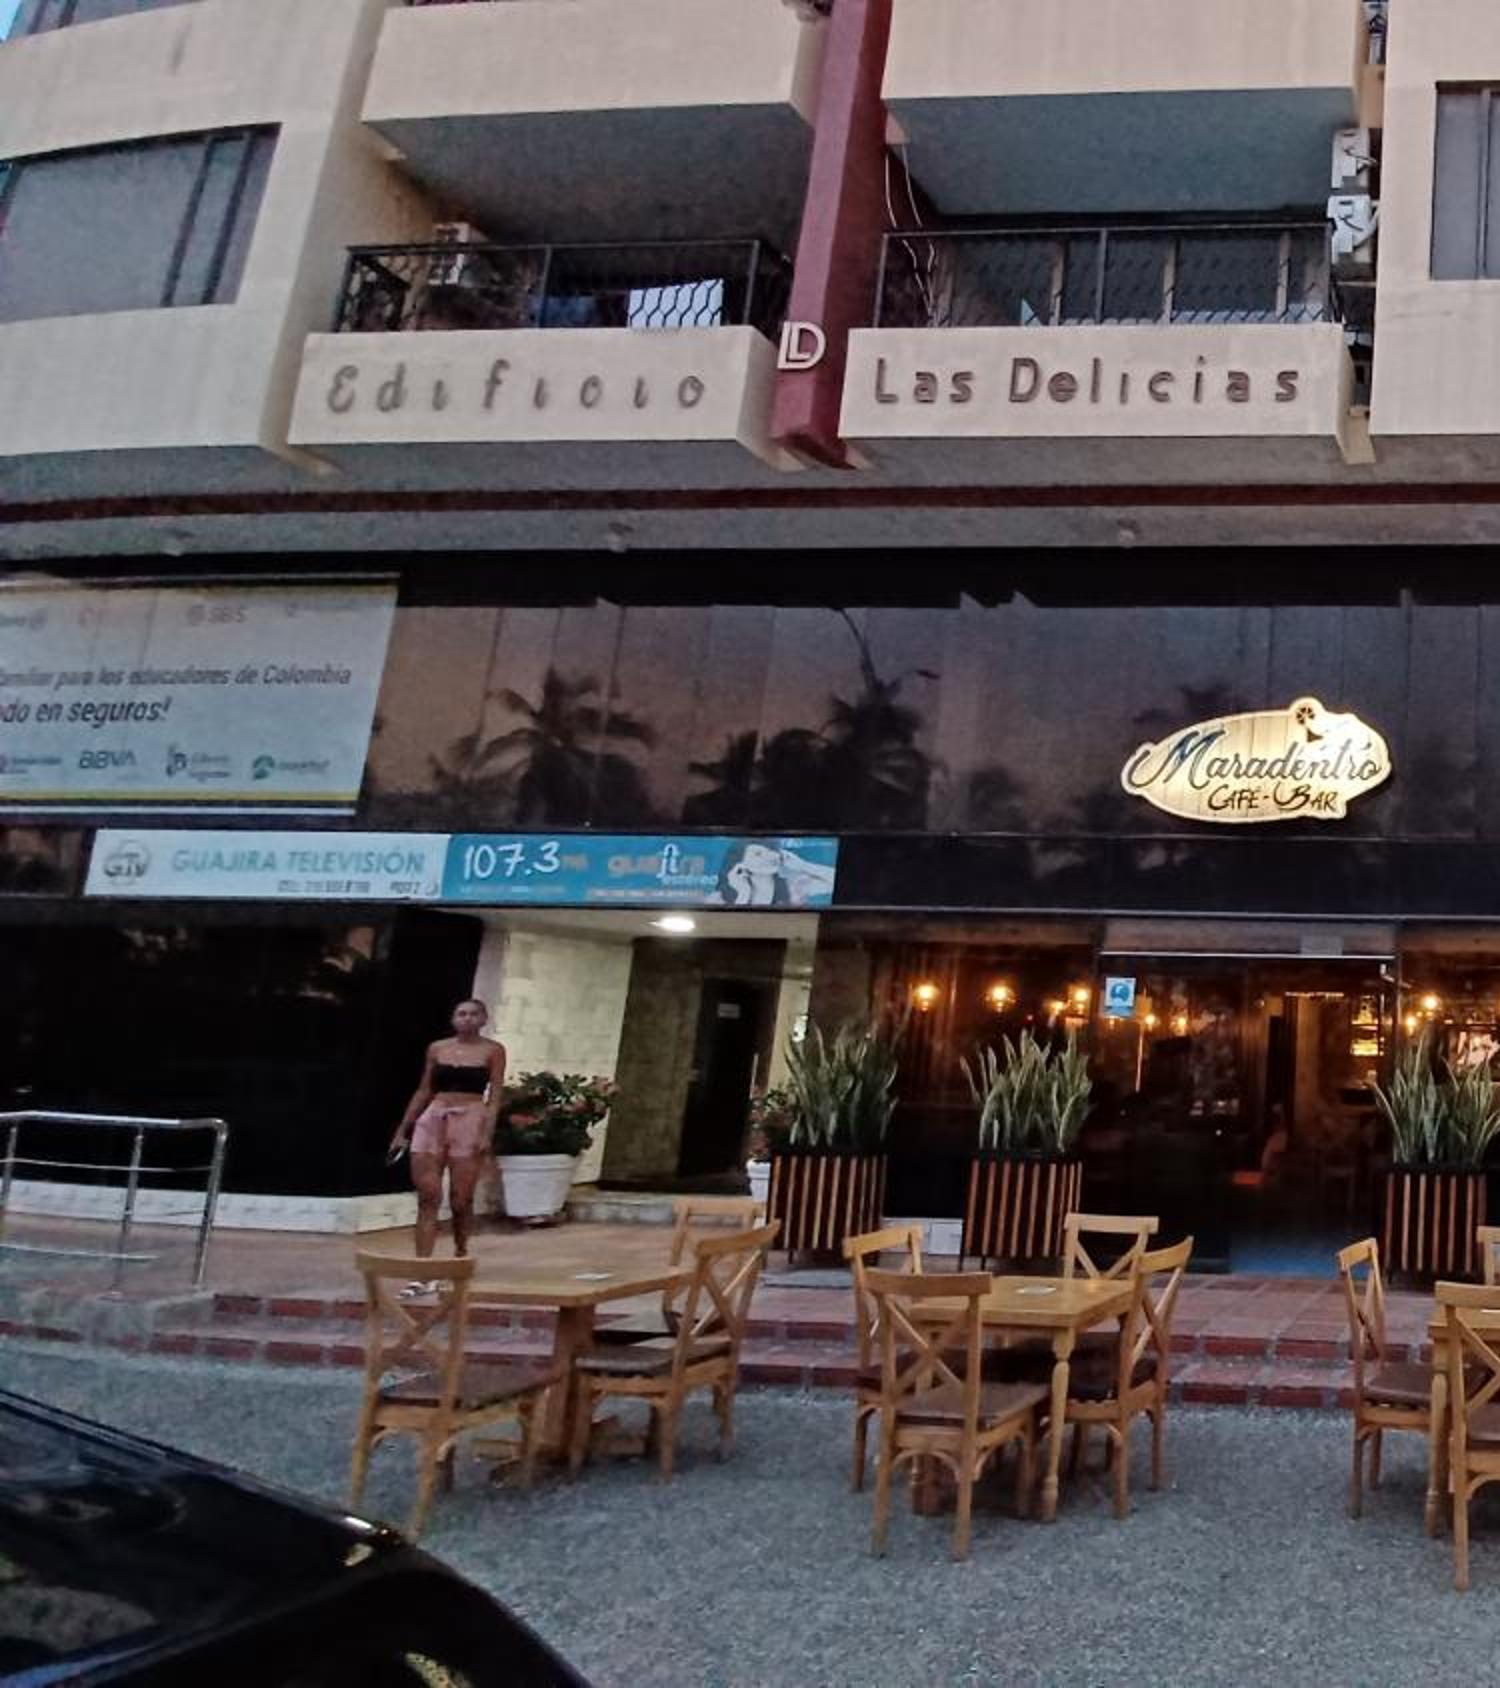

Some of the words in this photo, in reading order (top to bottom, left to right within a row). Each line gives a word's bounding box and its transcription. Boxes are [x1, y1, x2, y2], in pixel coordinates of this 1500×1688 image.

[327, 358, 705, 414] Edificio
[875, 357, 974, 404] Las
[1008, 355, 1299, 405] Delicias
[235, 665, 258, 685] de
[263, 663, 352, 685] Colombia
[36, 702, 63, 723] en
[67, 696, 173, 729] seguros!
[78, 750, 137, 770] BBVA
[172, 849, 277, 873] GUAJIRA
[288, 845, 425, 875] TELEVISIÓN
[463, 841, 560, 881] 107.3
